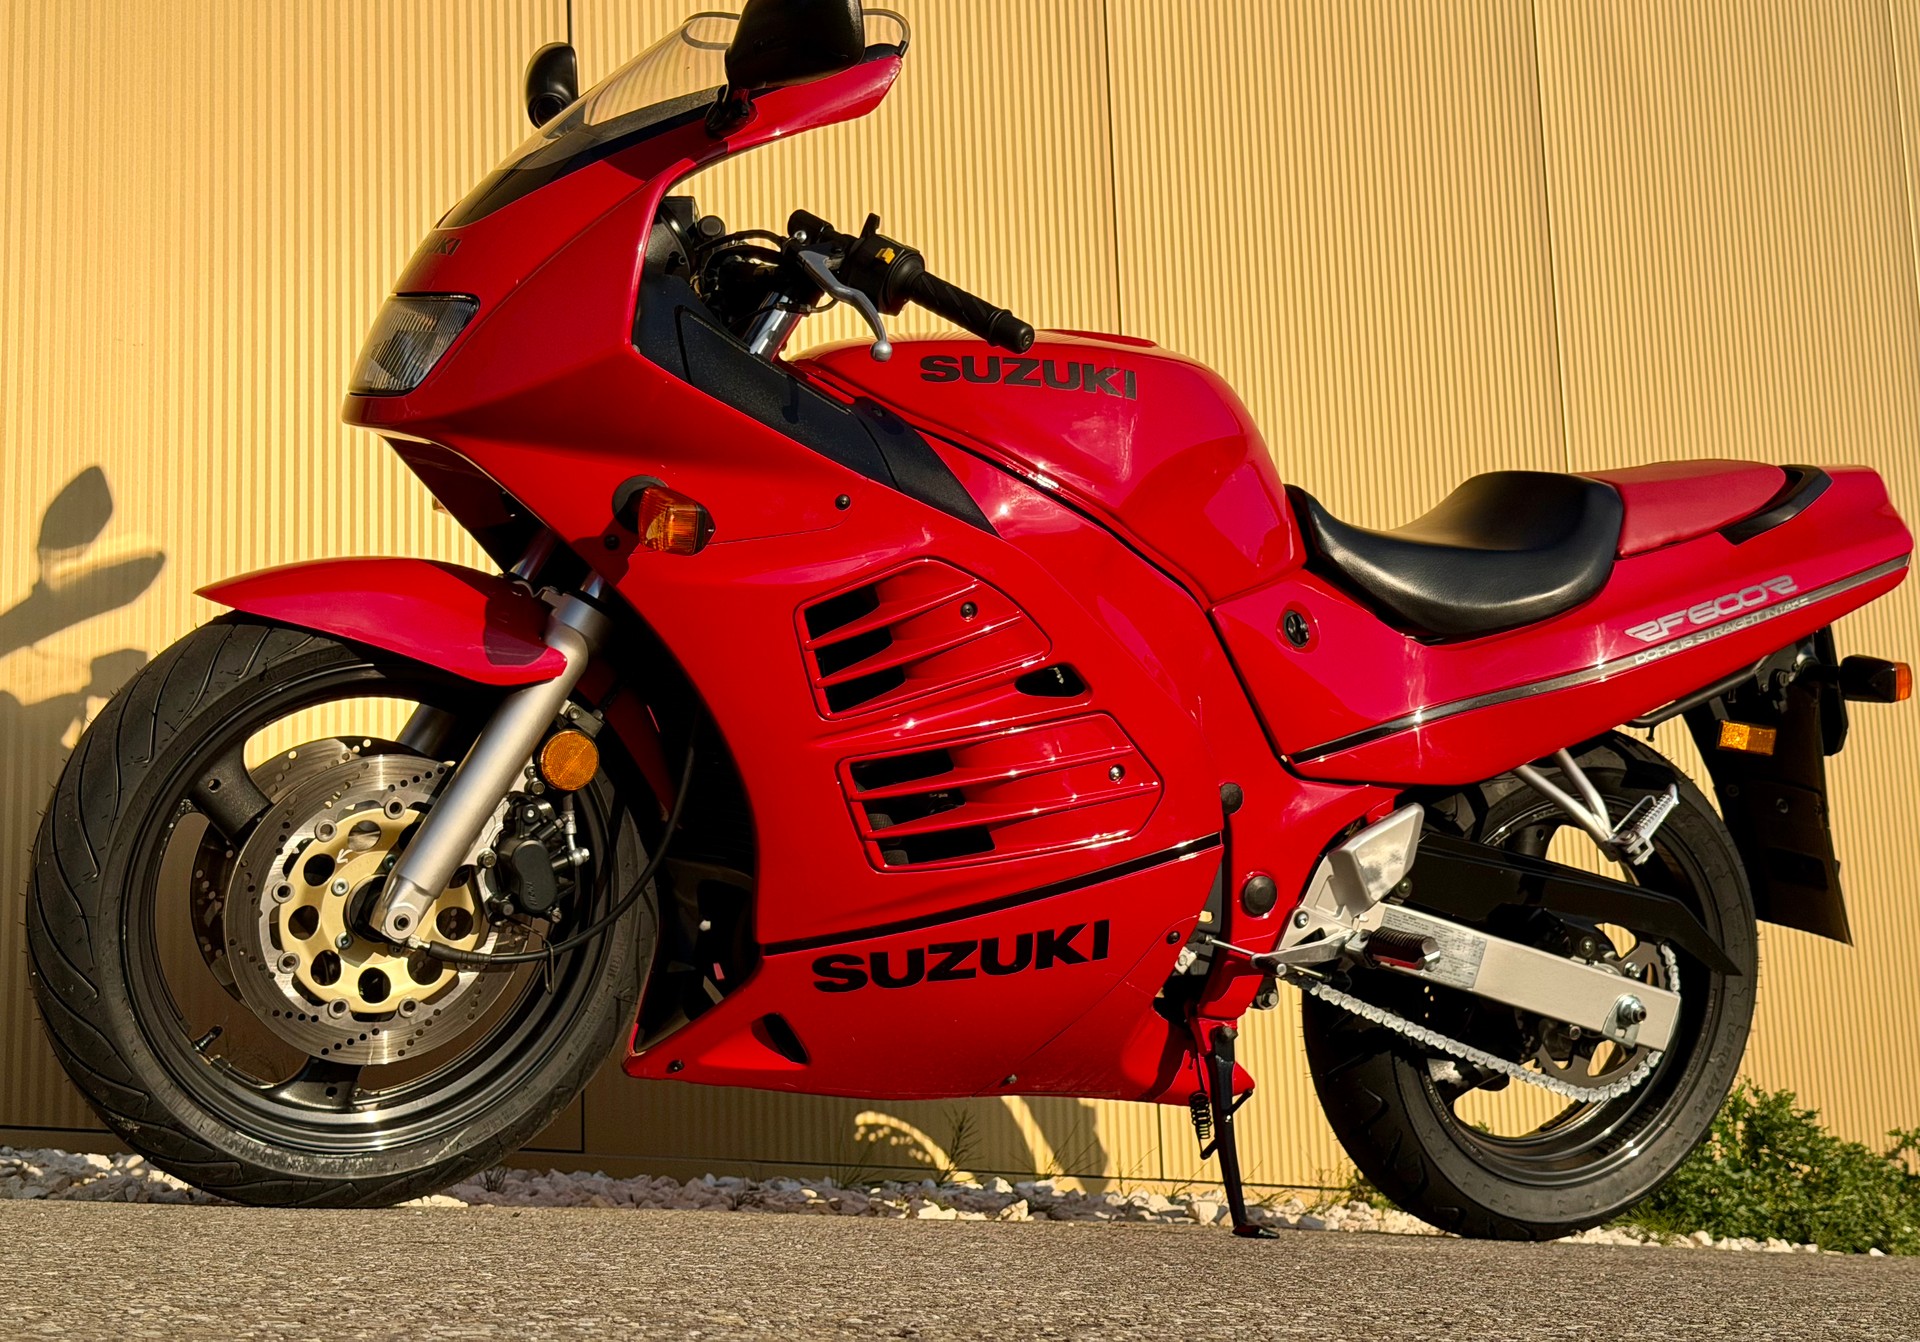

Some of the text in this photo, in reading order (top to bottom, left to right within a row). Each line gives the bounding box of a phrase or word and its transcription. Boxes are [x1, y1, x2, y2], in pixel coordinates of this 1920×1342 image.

[919, 355, 1138, 400] SUZUKI
[1625, 574, 1798, 643] RF600R
[1635, 641, 1681, 665] DOHC
[1696, 611, 1760, 644] STRAIGHT
[1764, 597, 1809, 619] INTAKE
[811, 919, 1110, 993] SUZUKI
